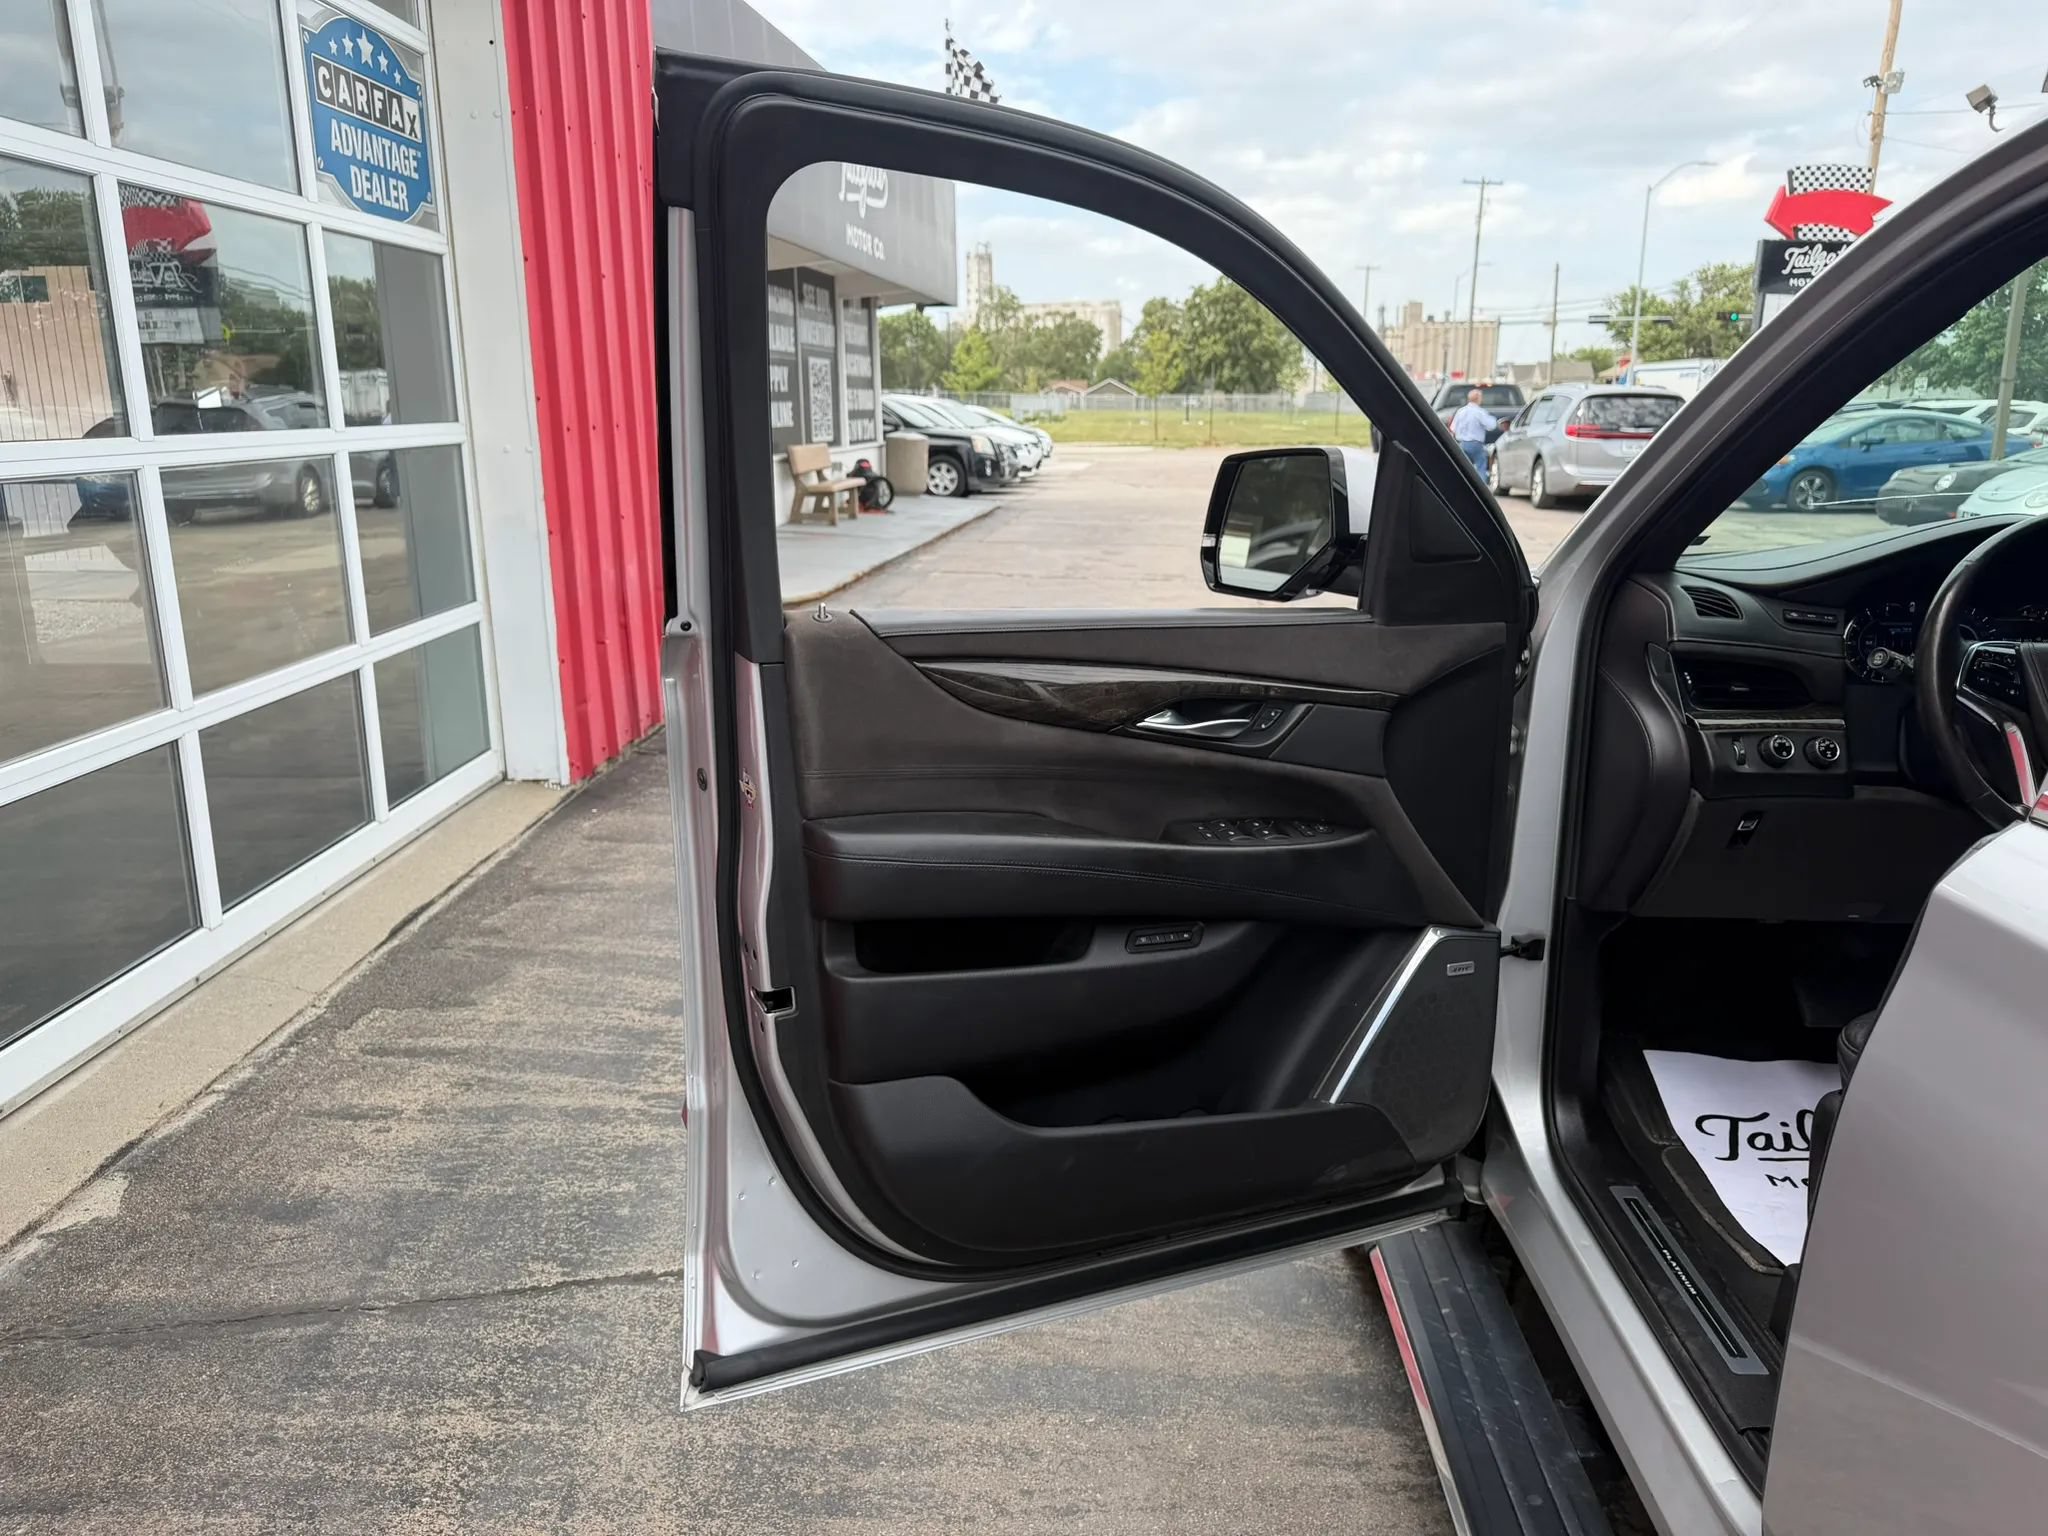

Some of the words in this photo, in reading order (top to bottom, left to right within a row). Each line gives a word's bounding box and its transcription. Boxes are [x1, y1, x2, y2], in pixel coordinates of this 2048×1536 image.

[317, 65, 419, 139] CARFAX
[330, 118, 420, 180] ADVANTAGE
[349, 164, 410, 213] DEALER
[845, 223, 873, 256] MOTOR
[1662, 1249, 1697, 1295] PLATINUM
